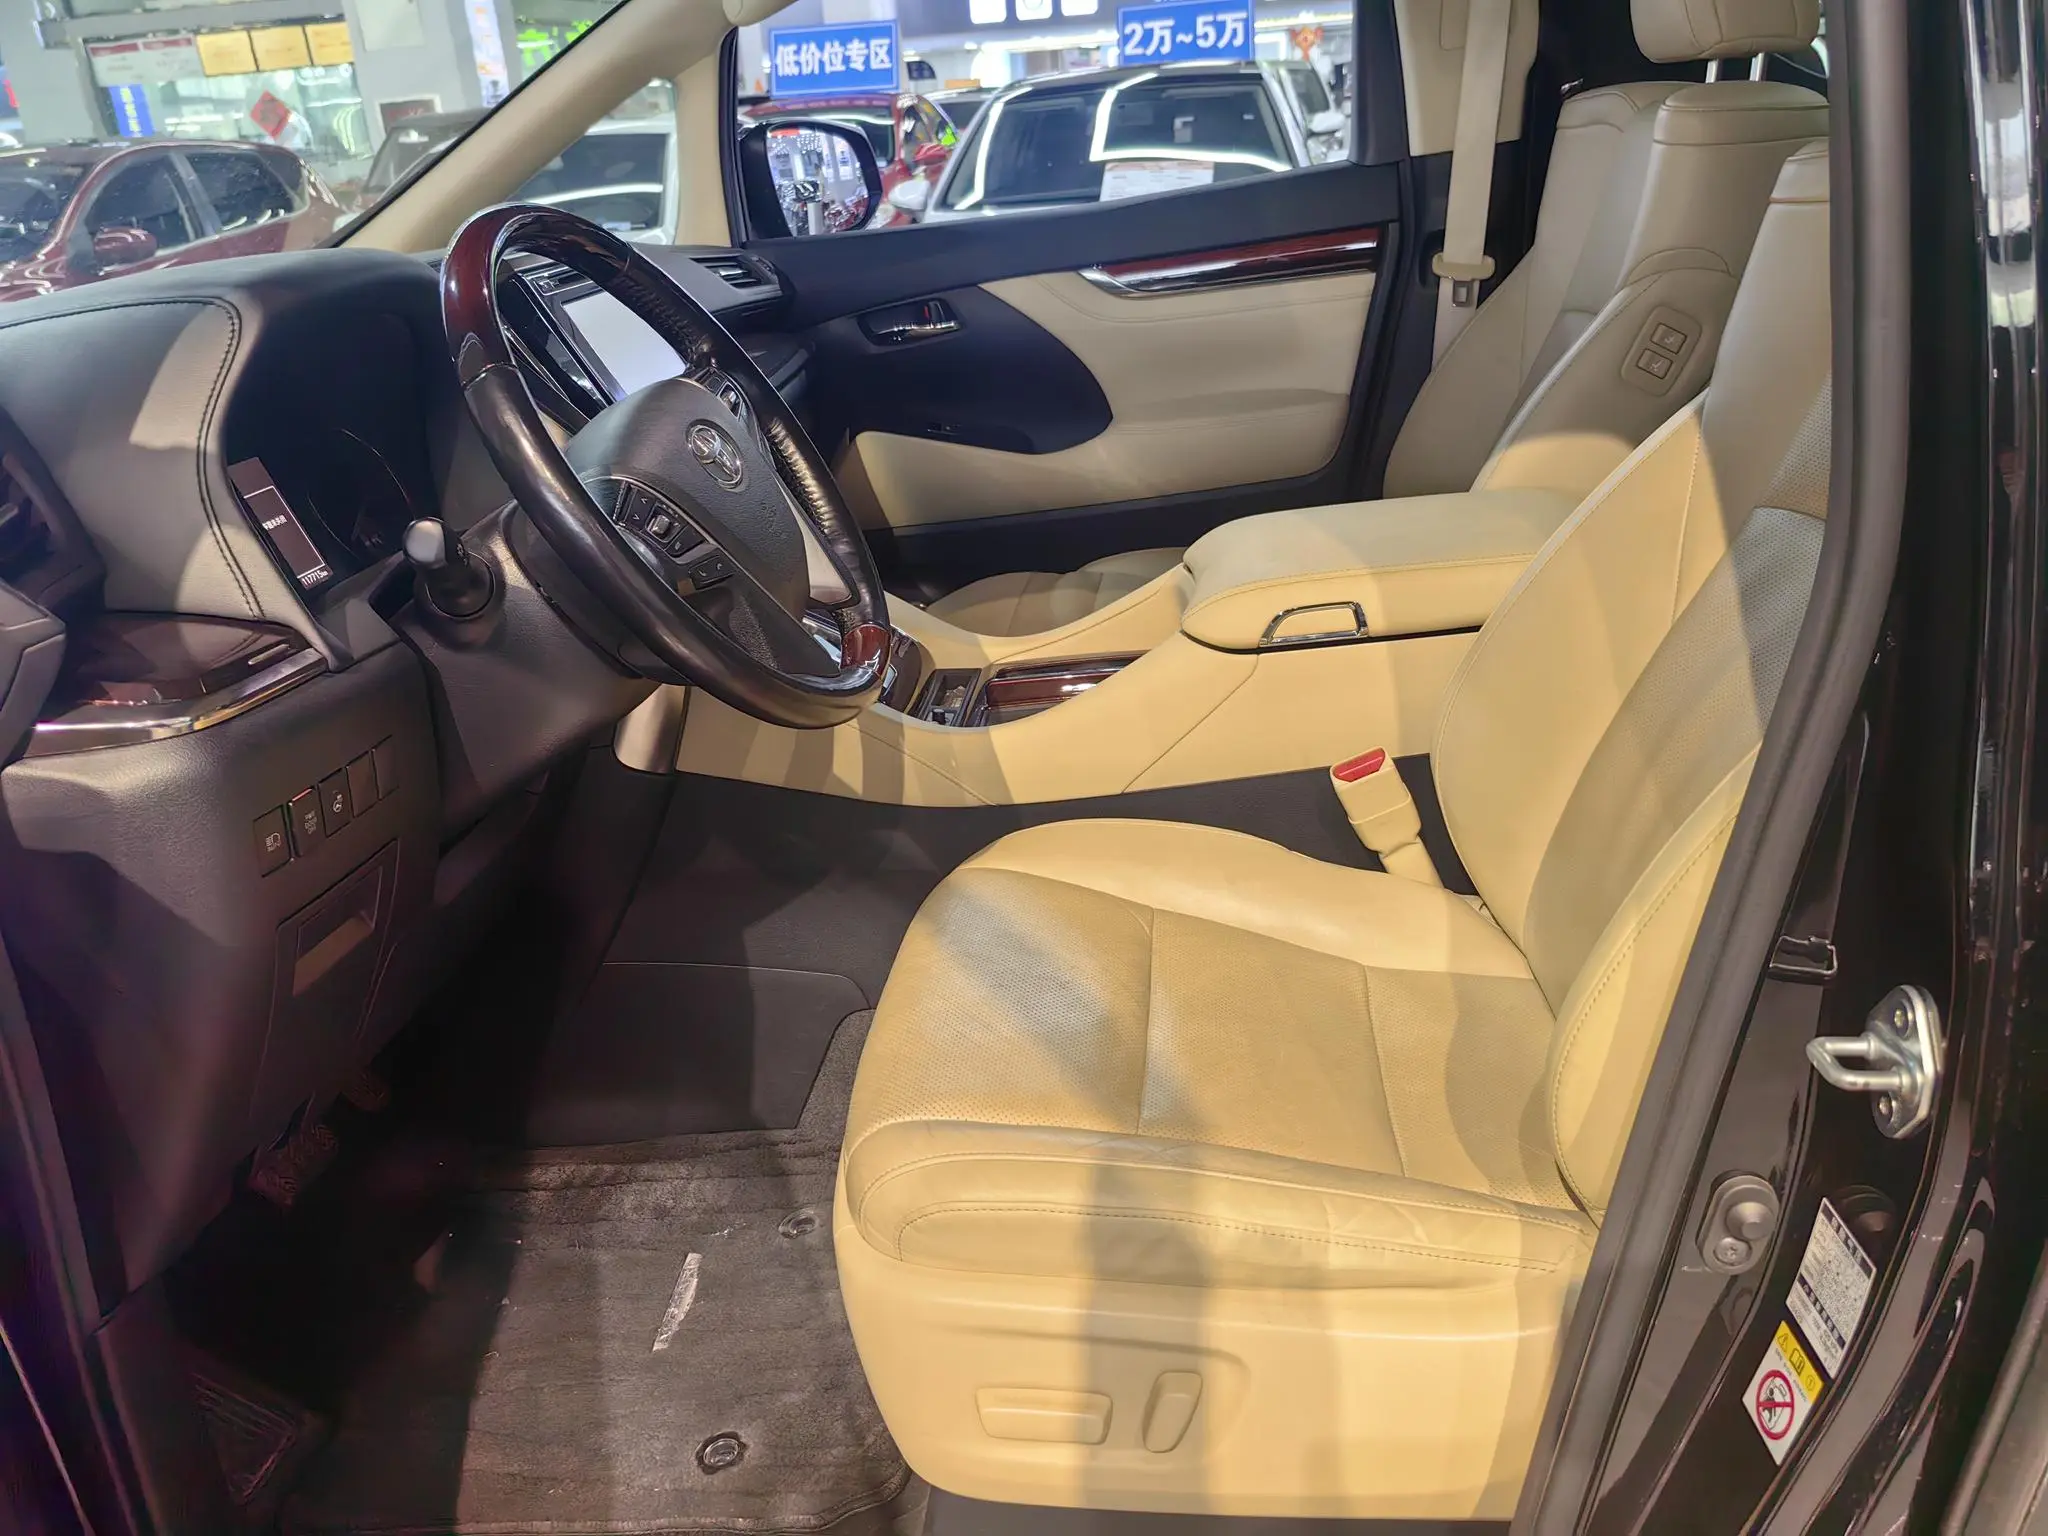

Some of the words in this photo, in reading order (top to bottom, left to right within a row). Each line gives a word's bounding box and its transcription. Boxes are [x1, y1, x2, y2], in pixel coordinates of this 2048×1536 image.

[776, 39, 892, 77] 低价位专区
